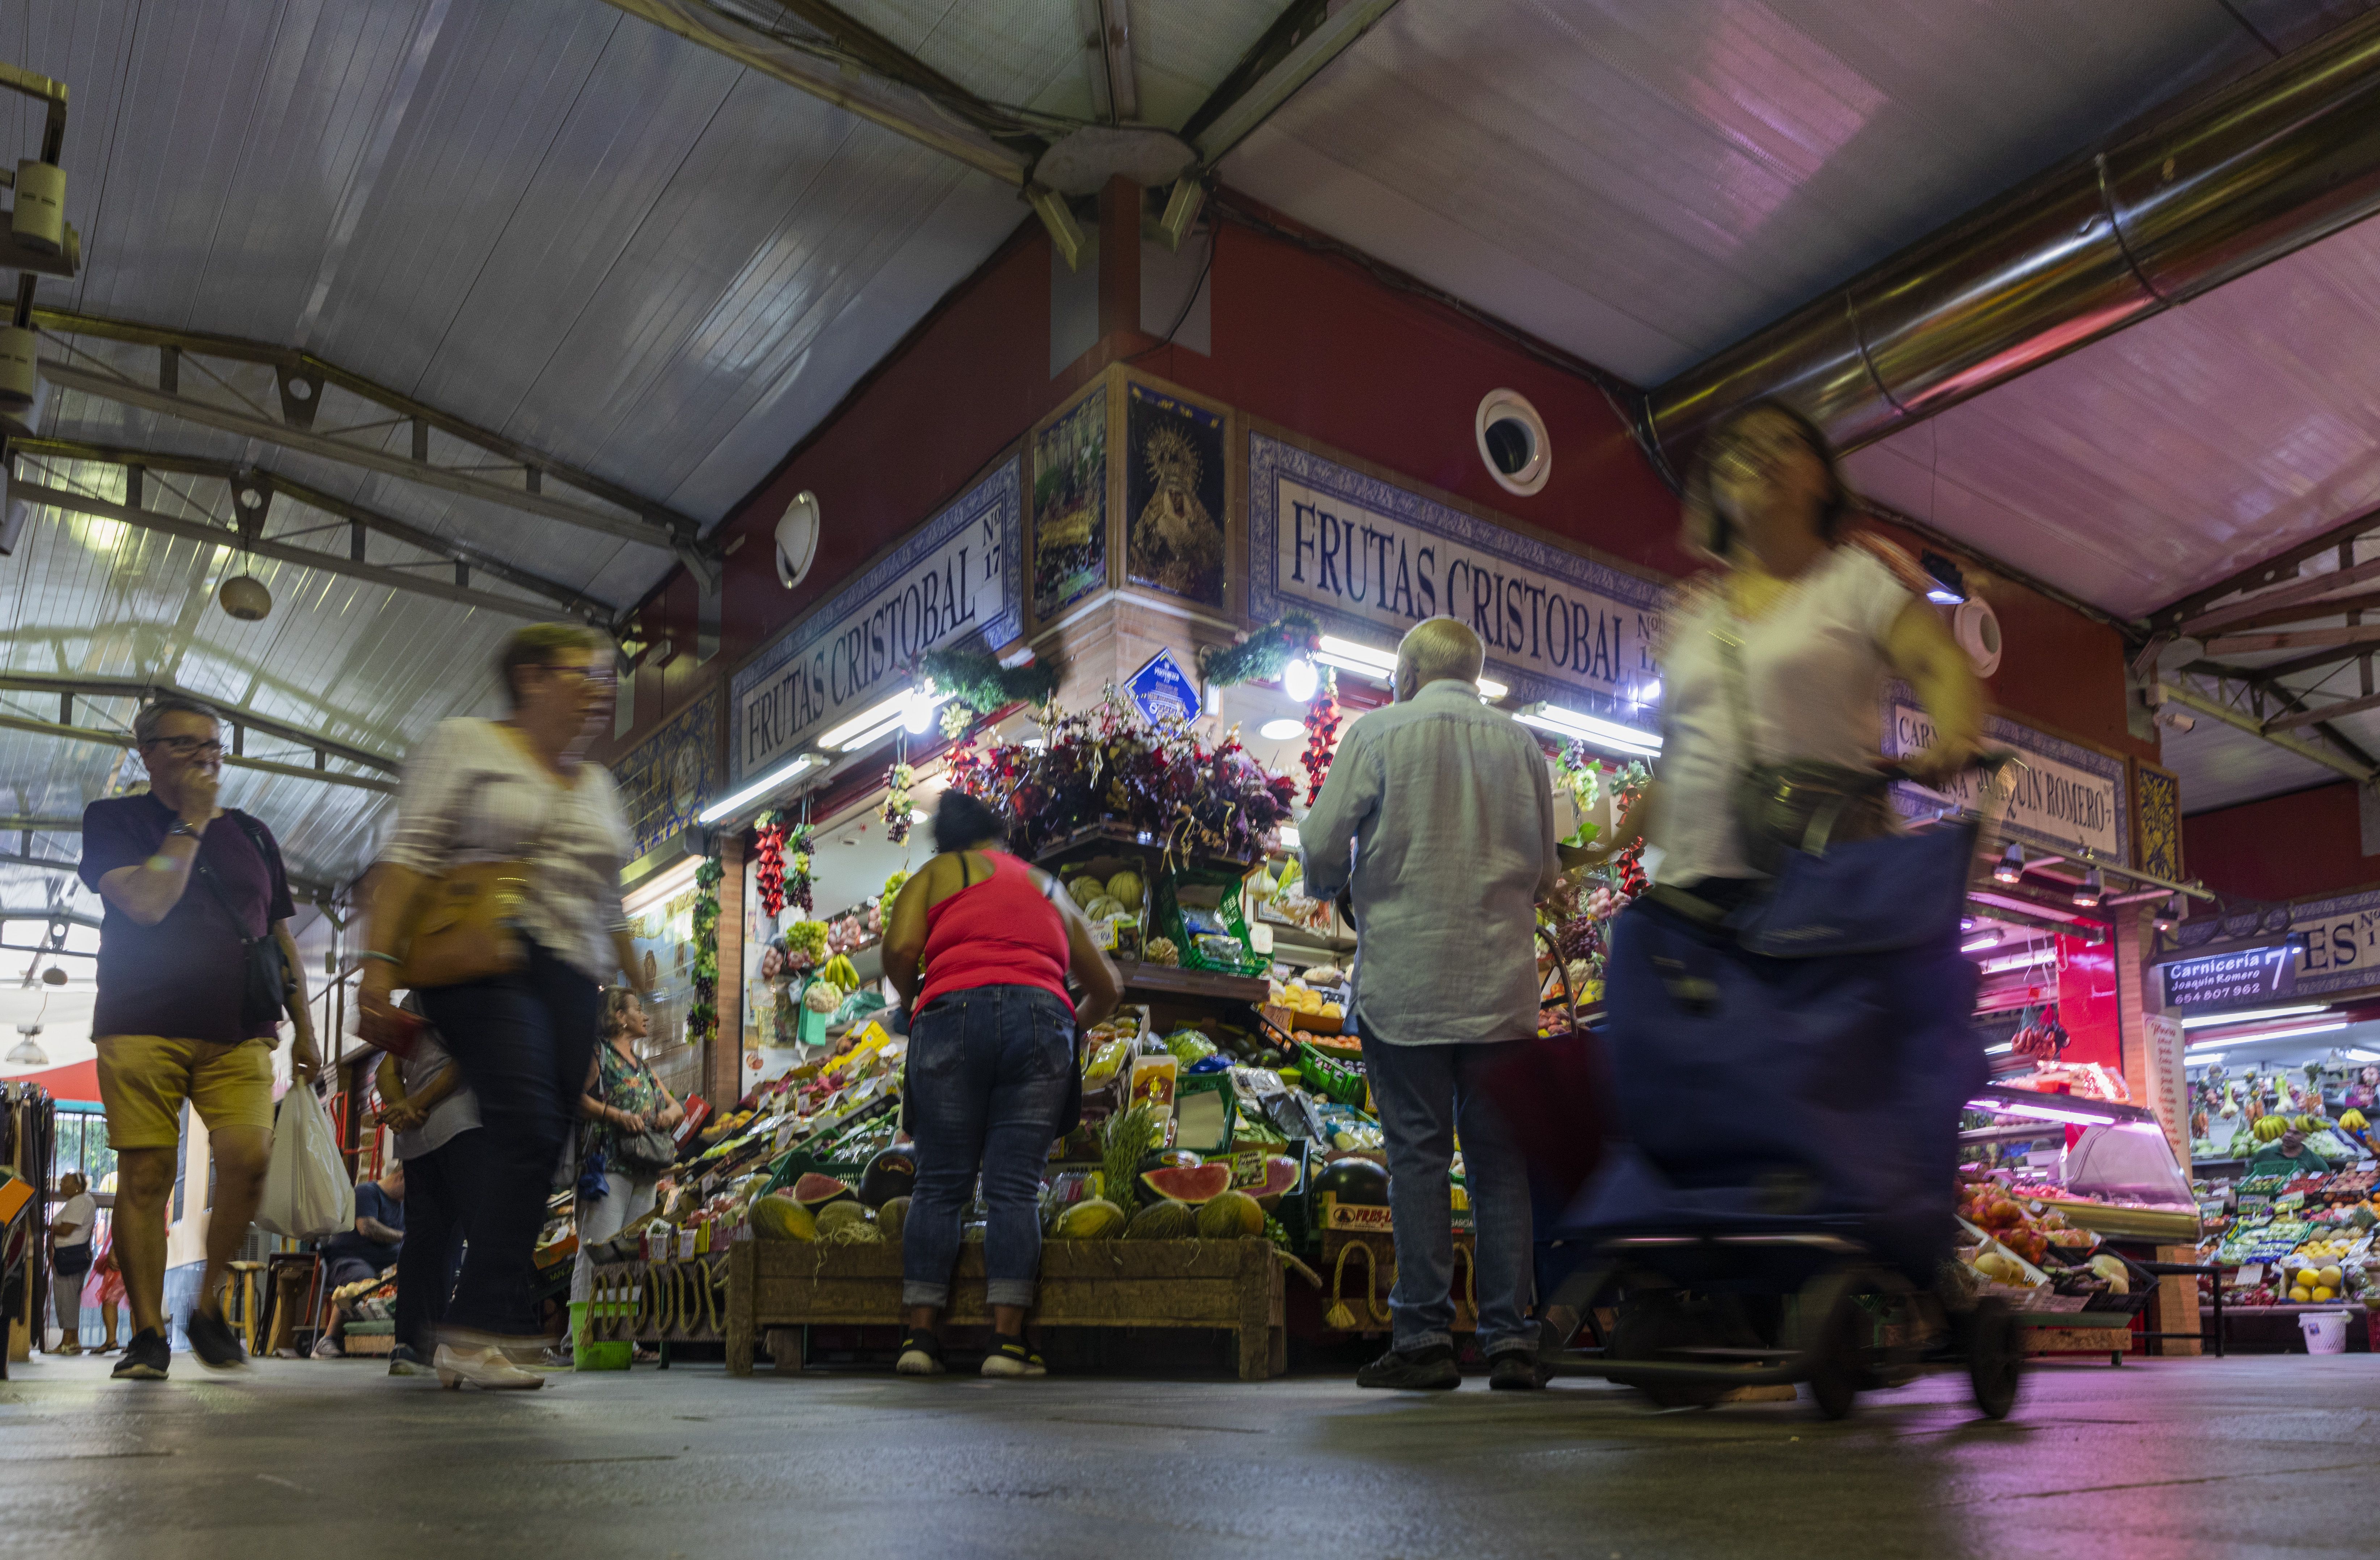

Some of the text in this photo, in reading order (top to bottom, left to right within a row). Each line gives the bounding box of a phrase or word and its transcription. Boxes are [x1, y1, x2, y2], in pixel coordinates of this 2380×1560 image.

[984, 543, 1001, 582] 17
[1291, 499, 1630, 686] FRUTAS CRISTOBAL
[748, 546, 976, 765] FRUTAS CRISTOBAL
[2047, 771, 2106, 832] ROMERO
[2106, 808, 2112, 824] 7
[2171, 952, 2259, 979] Carnicería
[2301, 919, 2358, 972] ES
[2172, 969, 2260, 992] Joaquín Romero
[2265, 947, 2288, 991] 7
[1356, 1209, 1392, 1223] FRES-L
